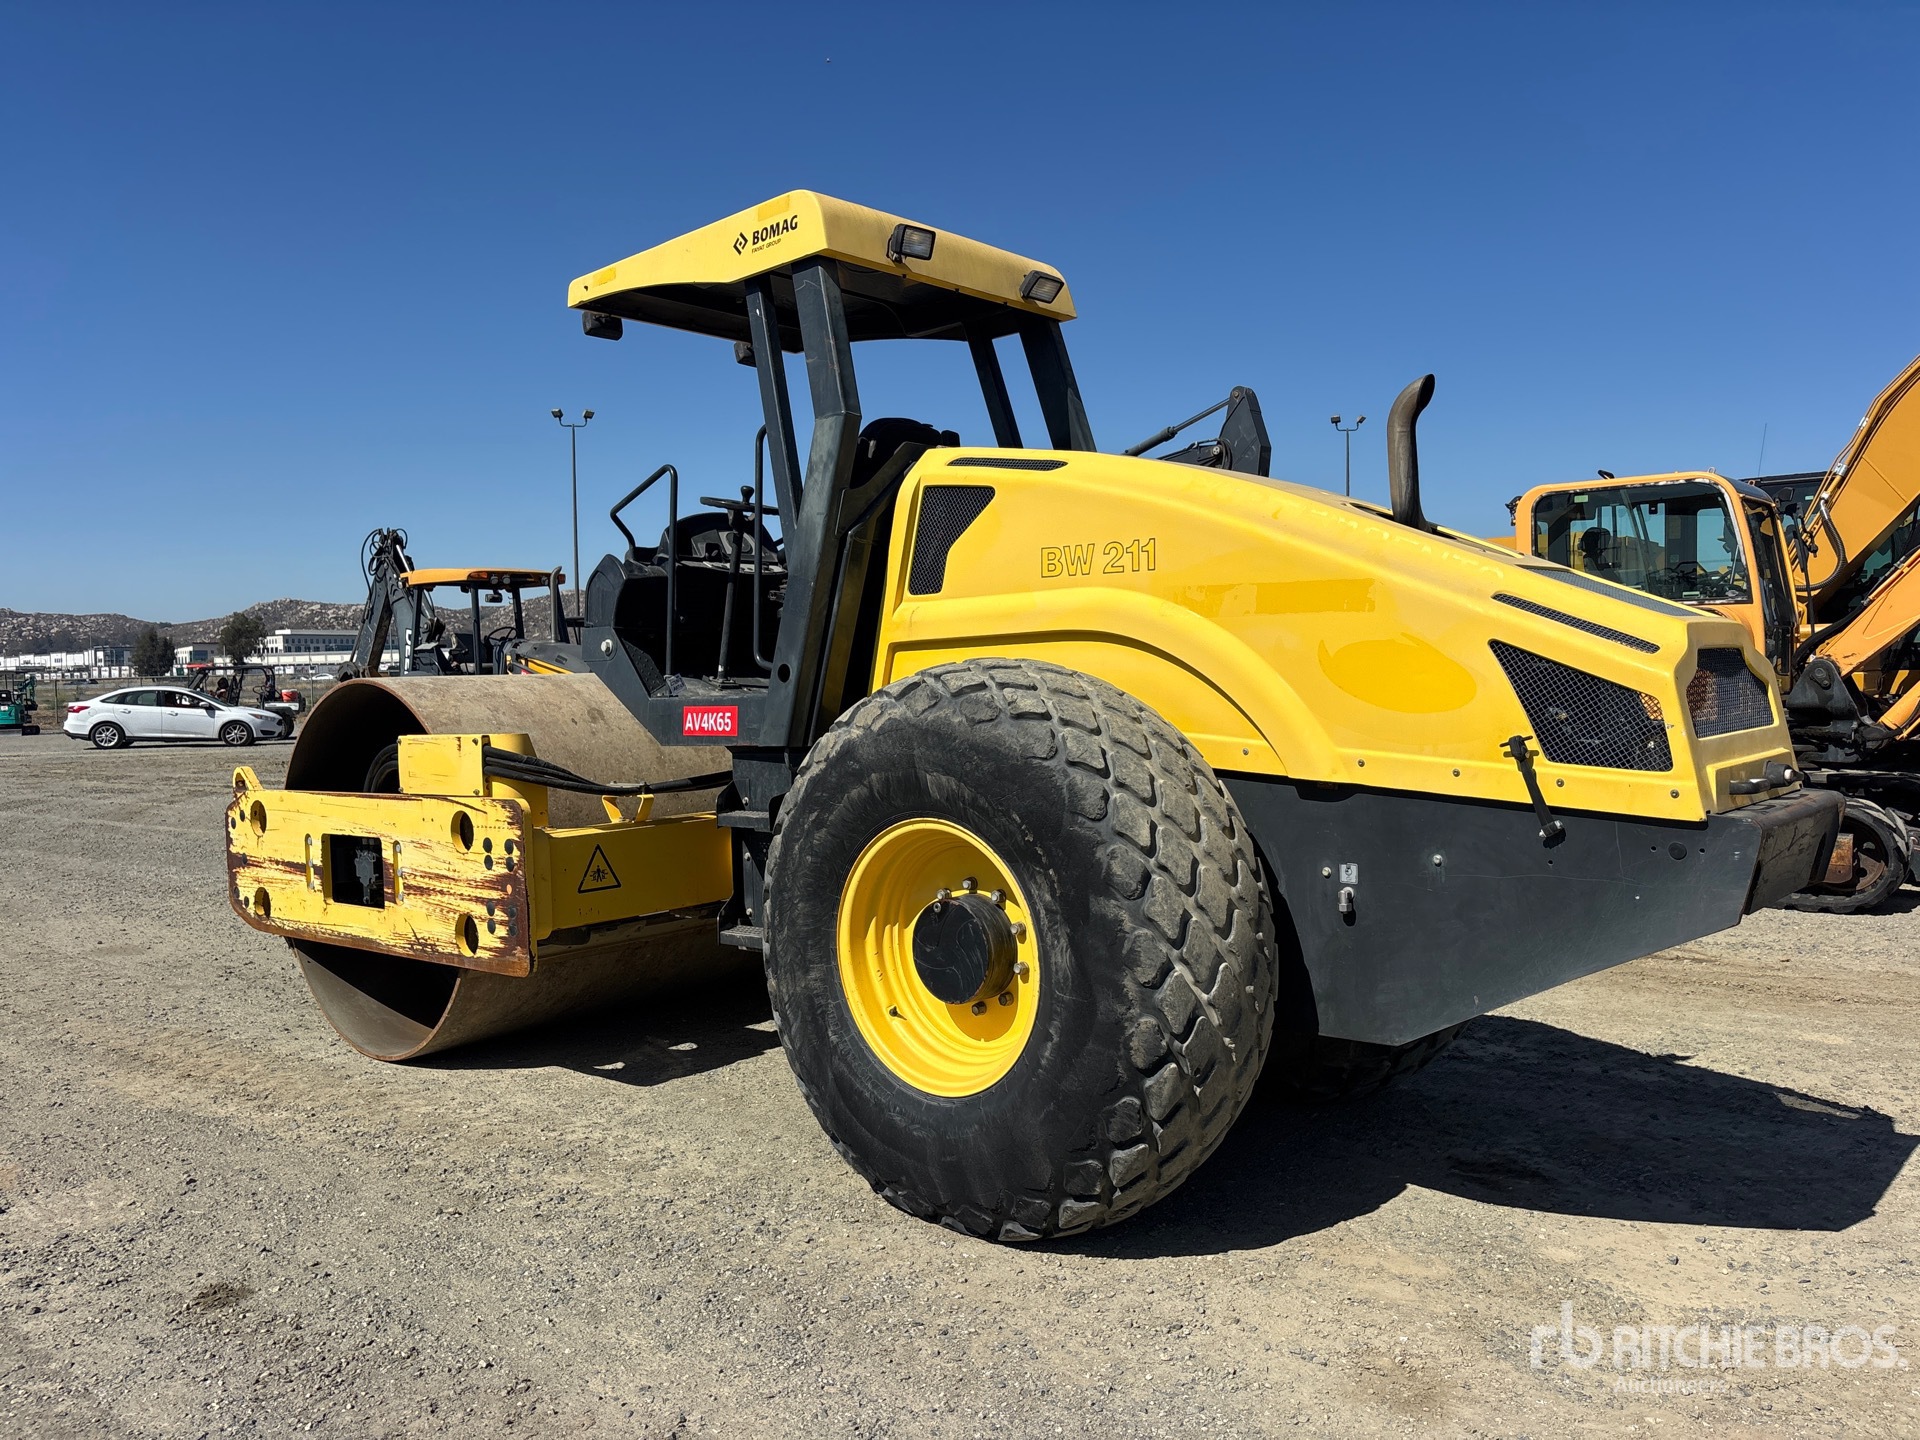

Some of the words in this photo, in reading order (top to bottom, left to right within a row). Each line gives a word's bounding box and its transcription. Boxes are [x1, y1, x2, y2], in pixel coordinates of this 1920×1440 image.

[752, 214, 798, 246] BOMAG
[766, 238, 782, 249] GROUP
[1040, 543, 1095, 578] BW
[1103, 537, 1156, 574] 211
[685, 712, 732, 732] AV4K65
